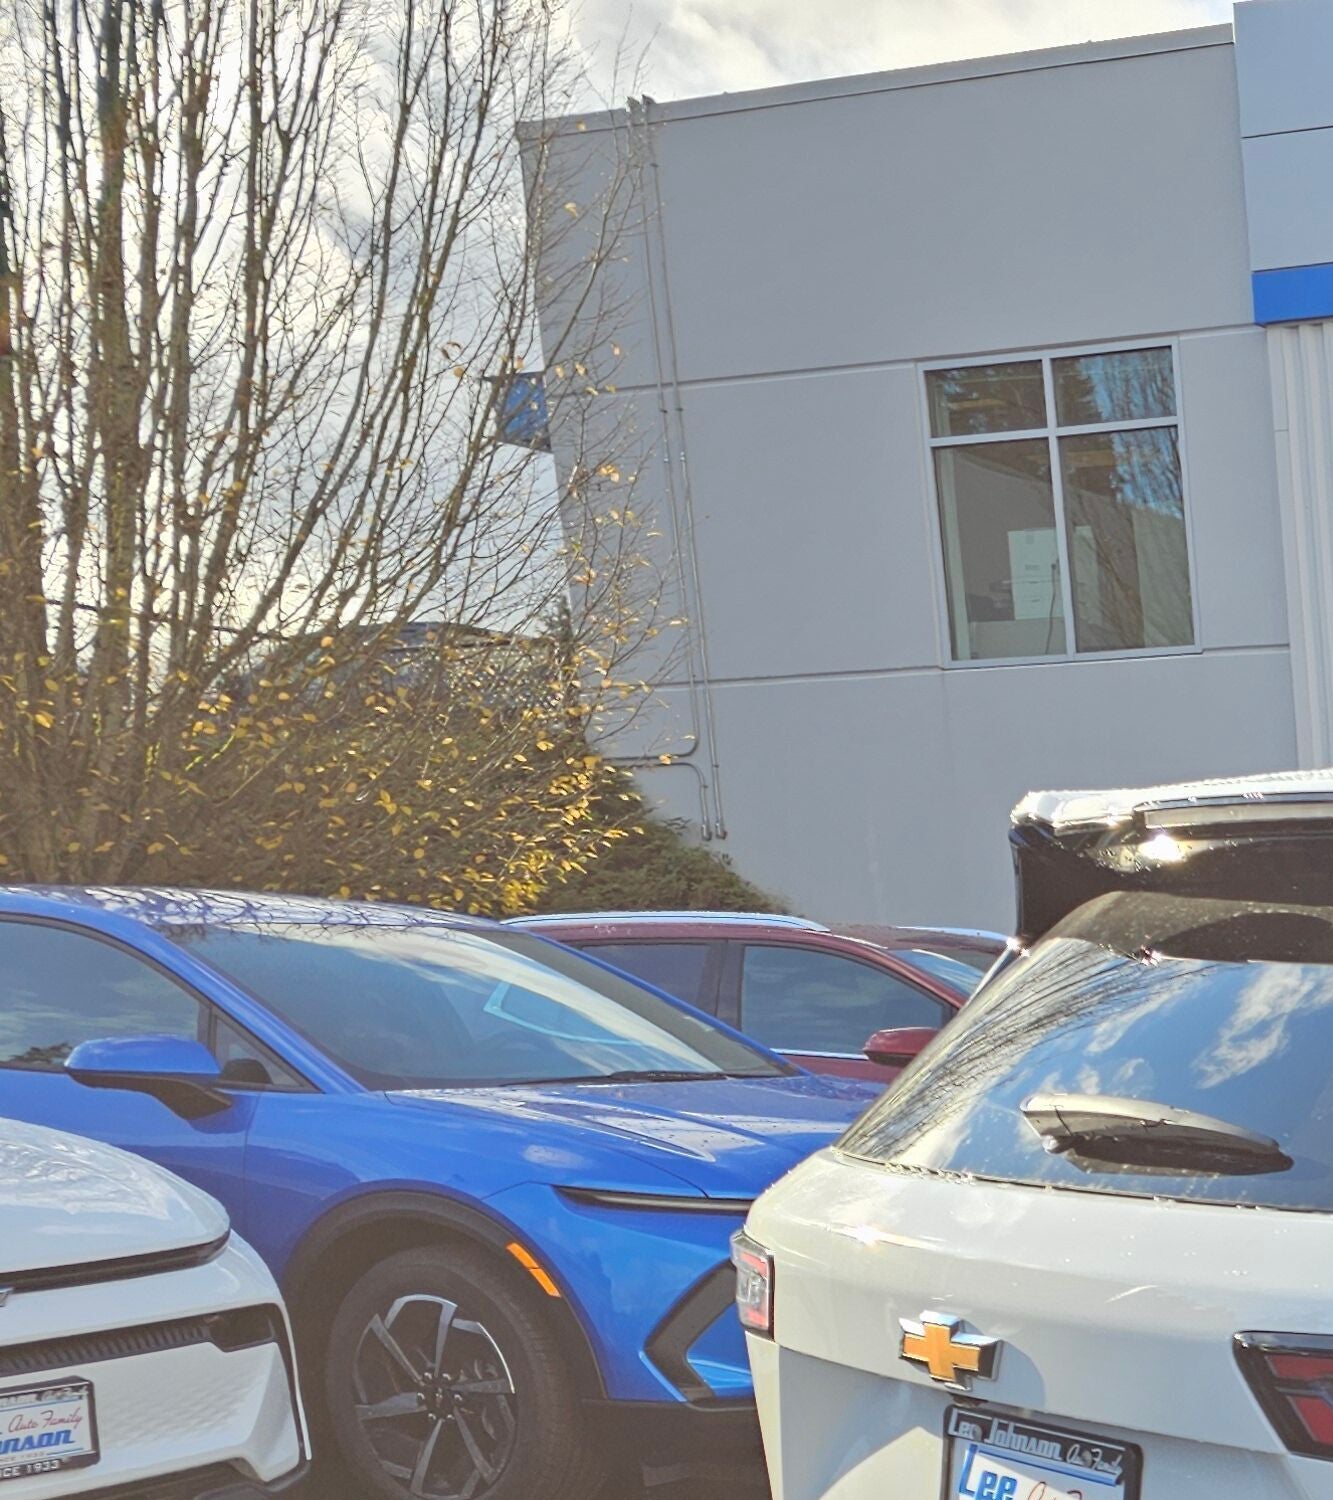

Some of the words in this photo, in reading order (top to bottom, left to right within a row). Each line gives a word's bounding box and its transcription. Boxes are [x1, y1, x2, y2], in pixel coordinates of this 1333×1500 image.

[9, 1414, 39, 1433] Auto
[41, 1407, 82, 1429] Family
[0, 1430, 75, 1455] nson
[984, 1420, 1063, 1460] Johnson
